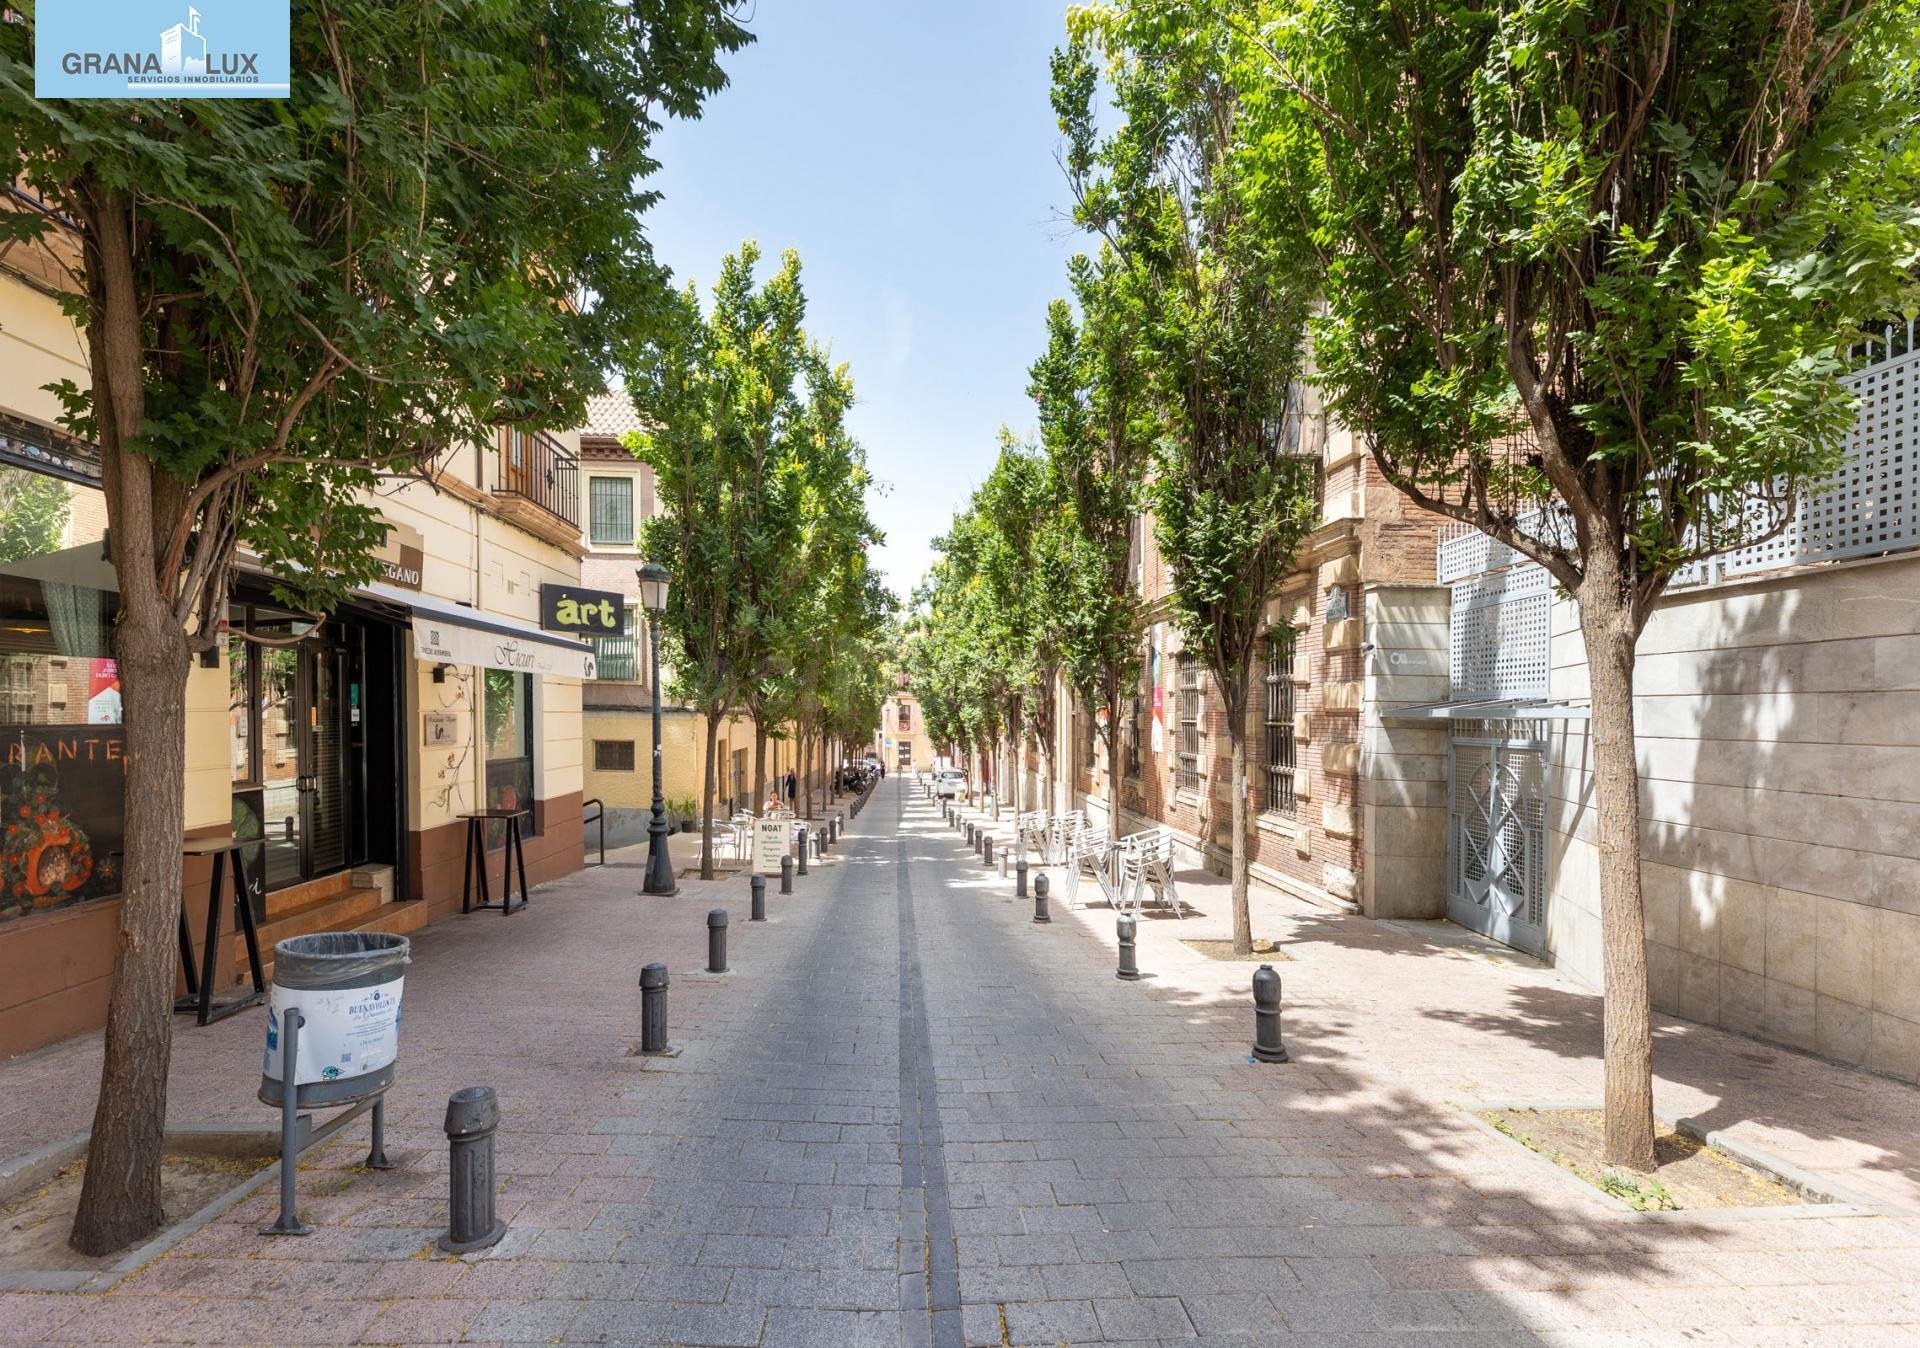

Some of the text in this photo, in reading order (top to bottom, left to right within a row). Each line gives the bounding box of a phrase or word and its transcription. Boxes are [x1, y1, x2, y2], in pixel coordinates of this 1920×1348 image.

[380, 561, 420, 585] EGANO
[556, 599, 616, 628] art
[761, 824, 782, 832] NOAT
